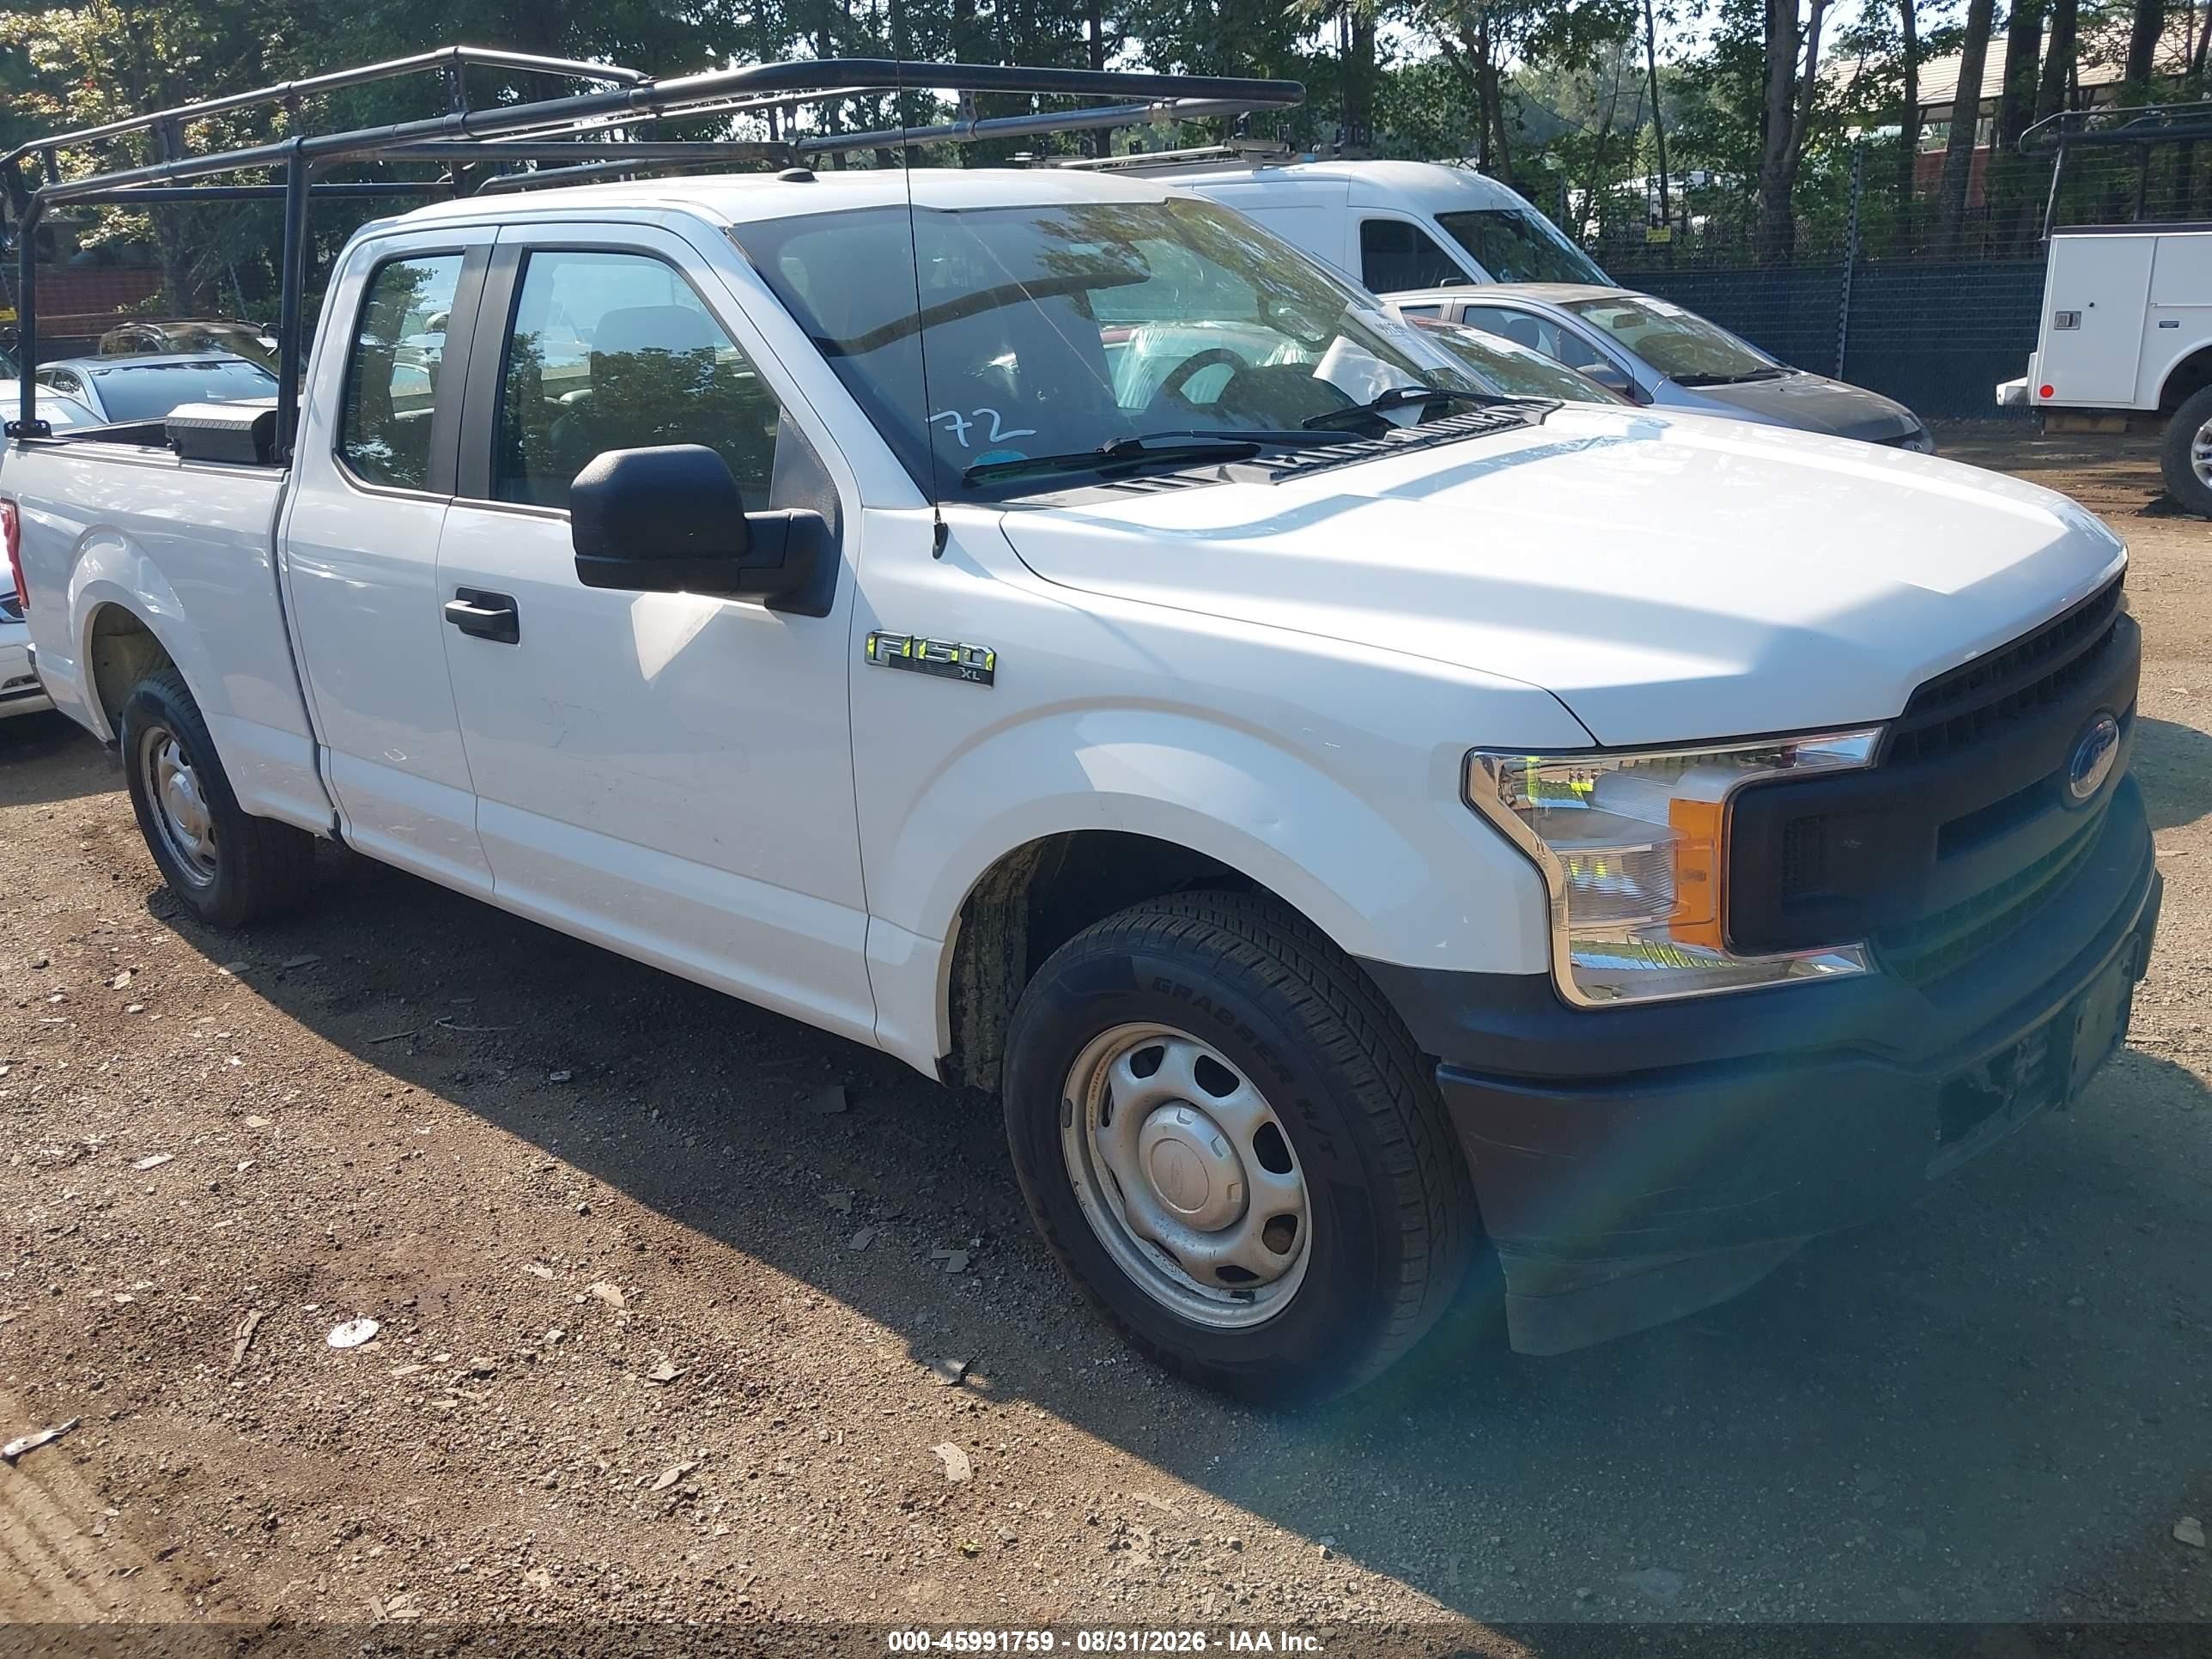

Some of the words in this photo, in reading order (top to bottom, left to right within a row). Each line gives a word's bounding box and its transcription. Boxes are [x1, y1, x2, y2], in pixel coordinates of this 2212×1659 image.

[925, 408, 1037, 447] 72
[961, 668, 981, 681] XL
[1152, 975, 1296, 1084] GRABBER
